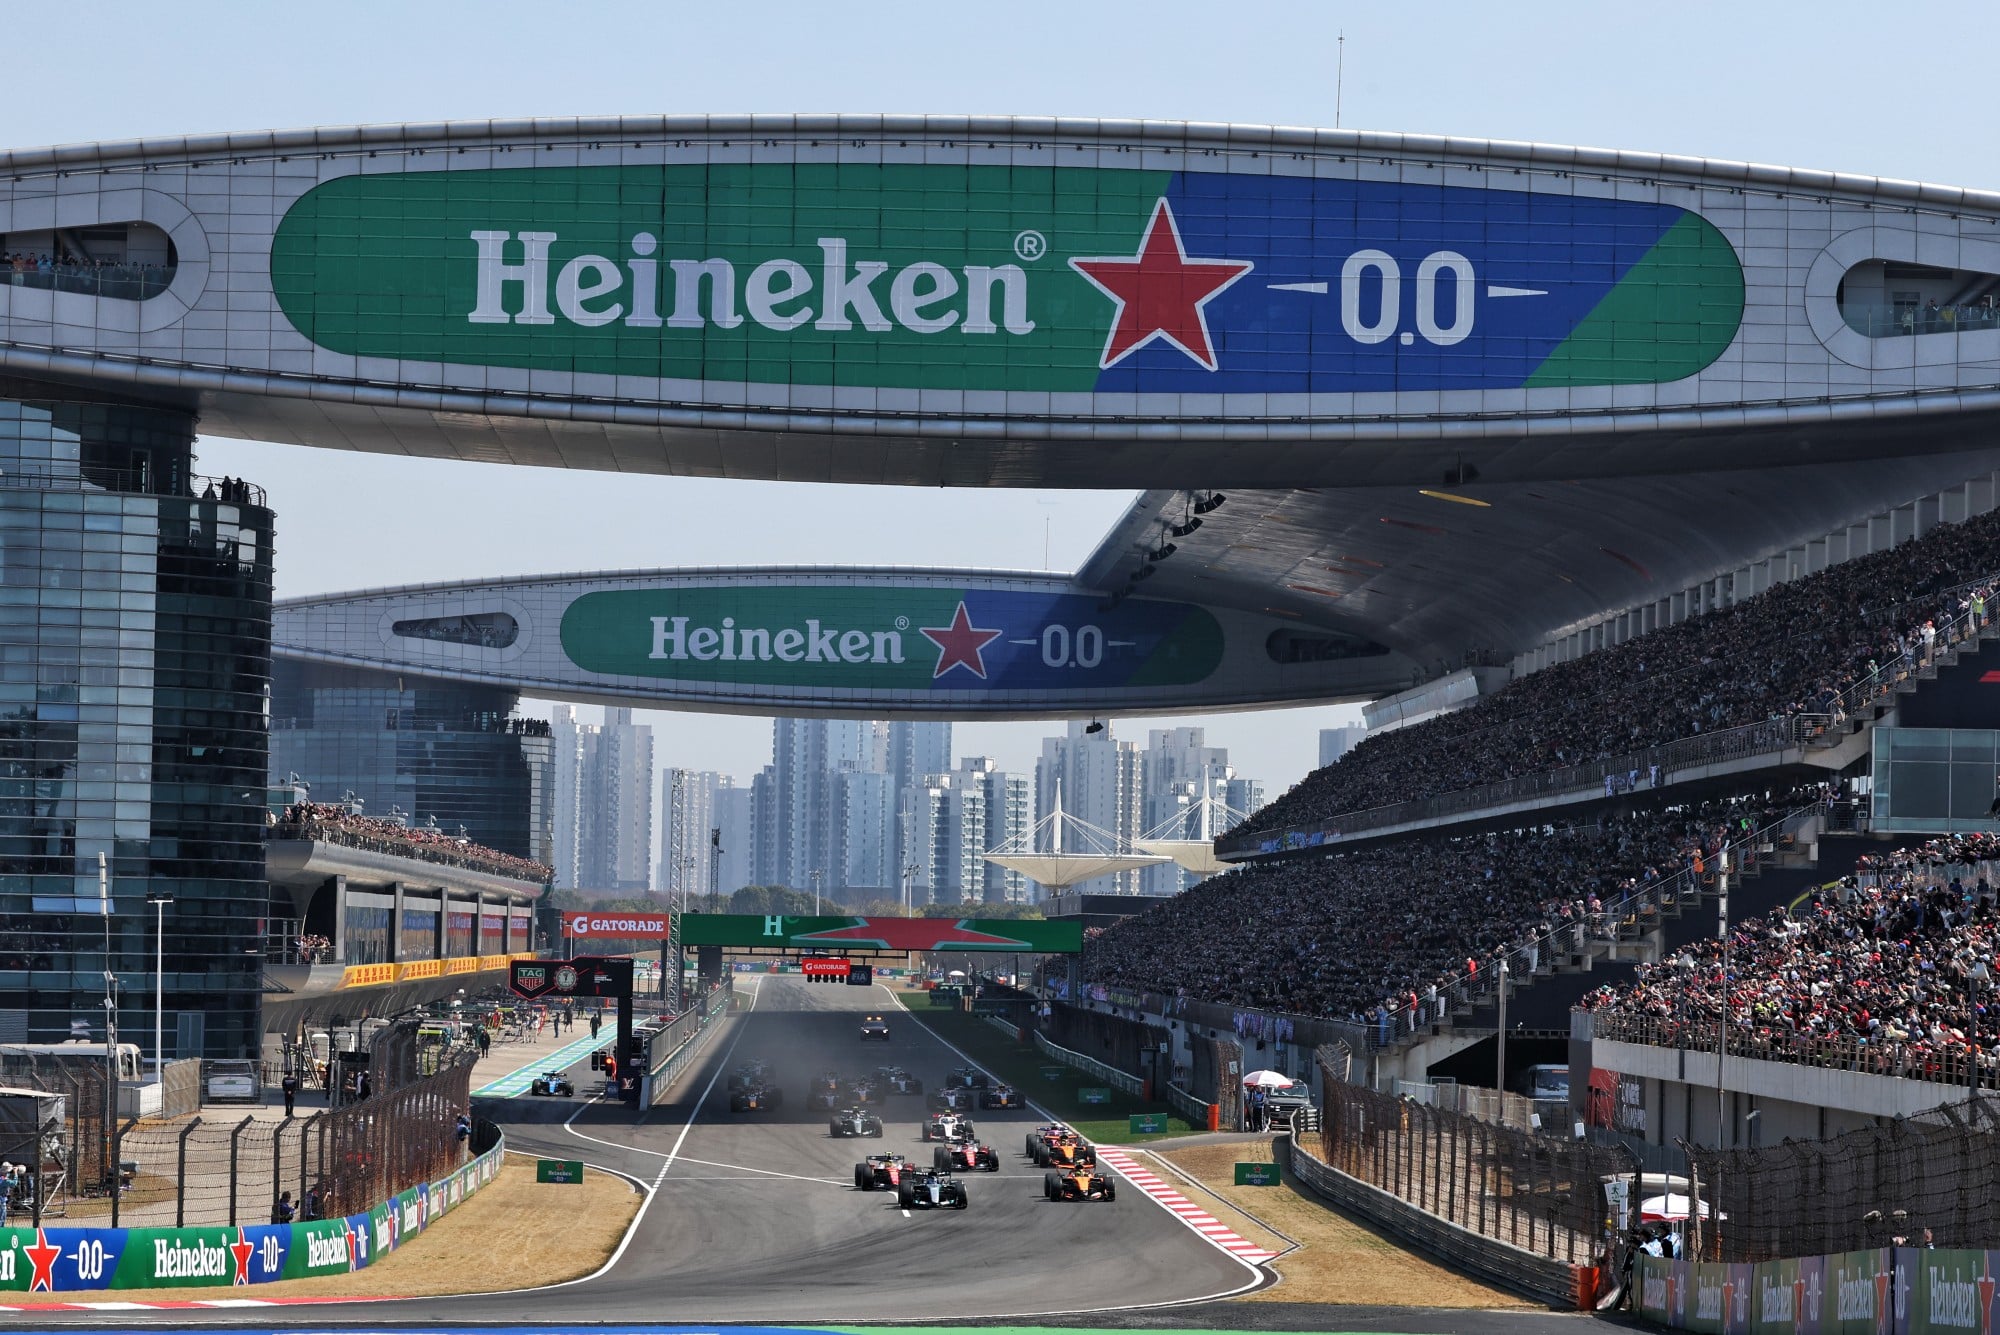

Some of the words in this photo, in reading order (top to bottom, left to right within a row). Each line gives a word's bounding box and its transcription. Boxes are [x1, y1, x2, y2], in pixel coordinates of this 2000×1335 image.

[1341, 249, 1475, 346] 0.0
[591, 919, 664, 932] GATORADE
[520, 969, 543, 977] TAG
[519, 977, 543, 989] HEUER
